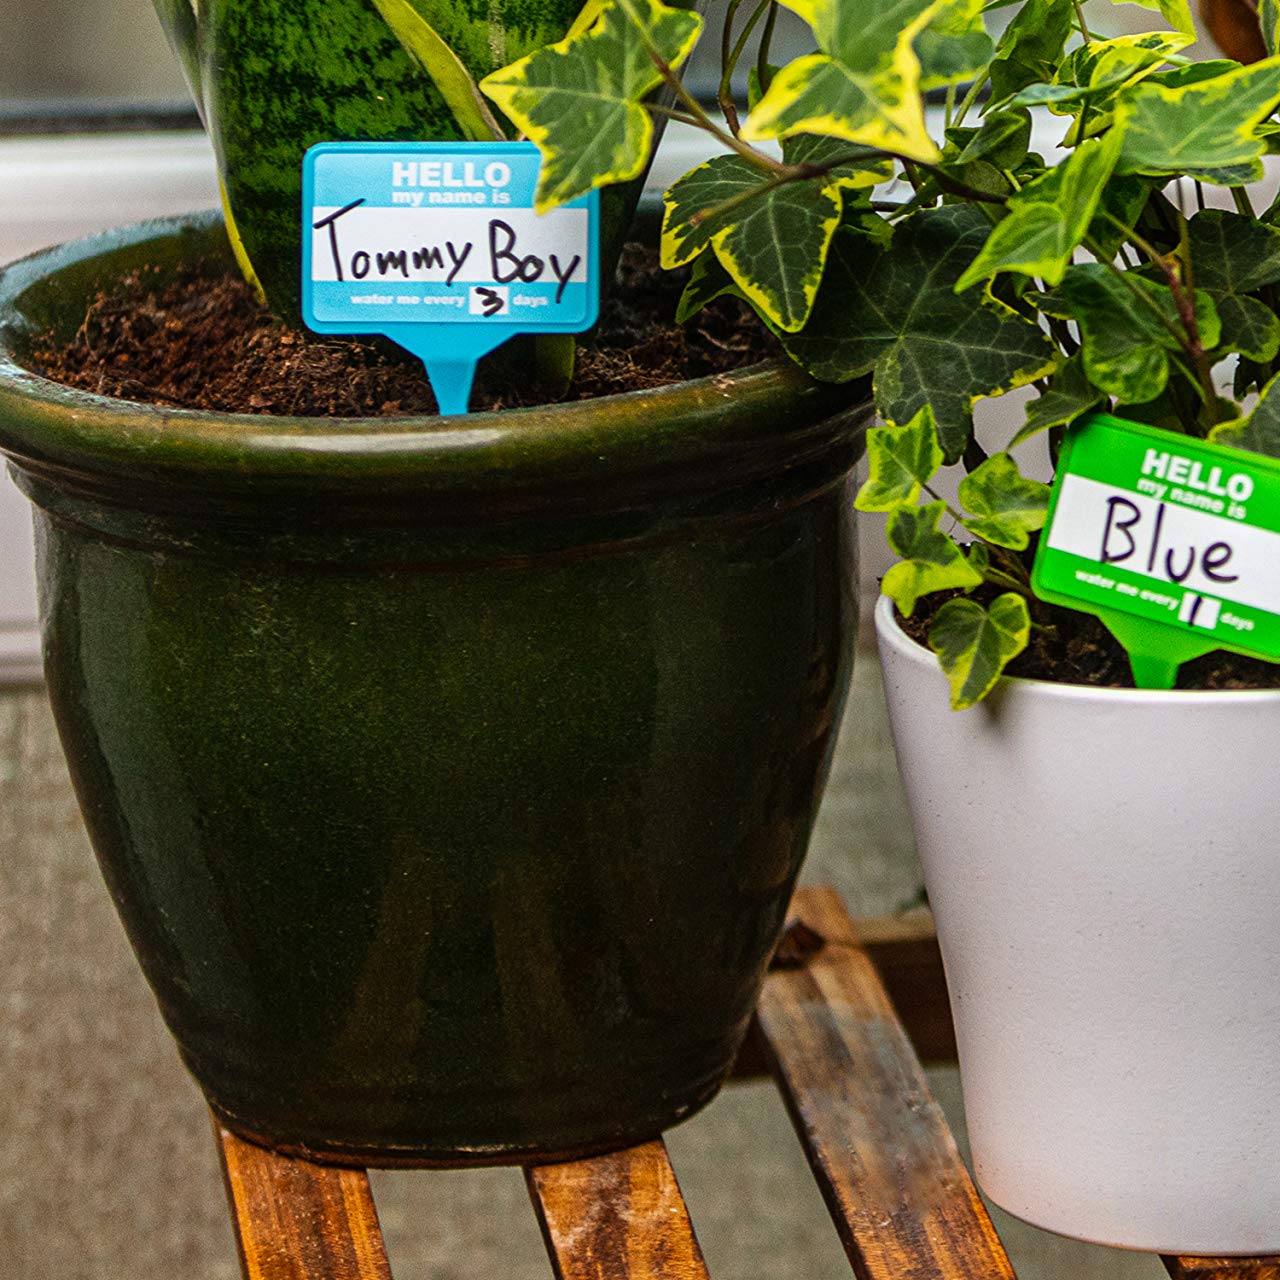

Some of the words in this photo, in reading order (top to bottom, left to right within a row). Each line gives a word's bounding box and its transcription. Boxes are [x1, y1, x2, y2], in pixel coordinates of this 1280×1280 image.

[392, 162, 511, 187] HELLO
[392, 191, 422, 206] my
[429, 191, 486, 203] name
[492, 189, 510, 204] is
[313, 198, 473, 287] Tommy
[489, 219, 581, 304] Boy
[351, 294, 394, 304] water
[397, 295, 420, 304] me
[424, 295, 465, 307] every
[475, 287, 504, 317] 3
[513, 294, 548, 307] days
[1137, 478, 1168, 501] my
[1170, 487, 1224, 513] name
[1228, 499, 1246, 520] is
[1141, 448, 1254, 502] HELLO
[1100, 496, 1239, 584] Blue
[1075, 570, 1114, 591] water
[1116, 581, 1139, 596] me
[1140, 589, 1179, 611] every
[1188, 595, 1203, 627] 1
[1220, 612, 1255, 631] days
